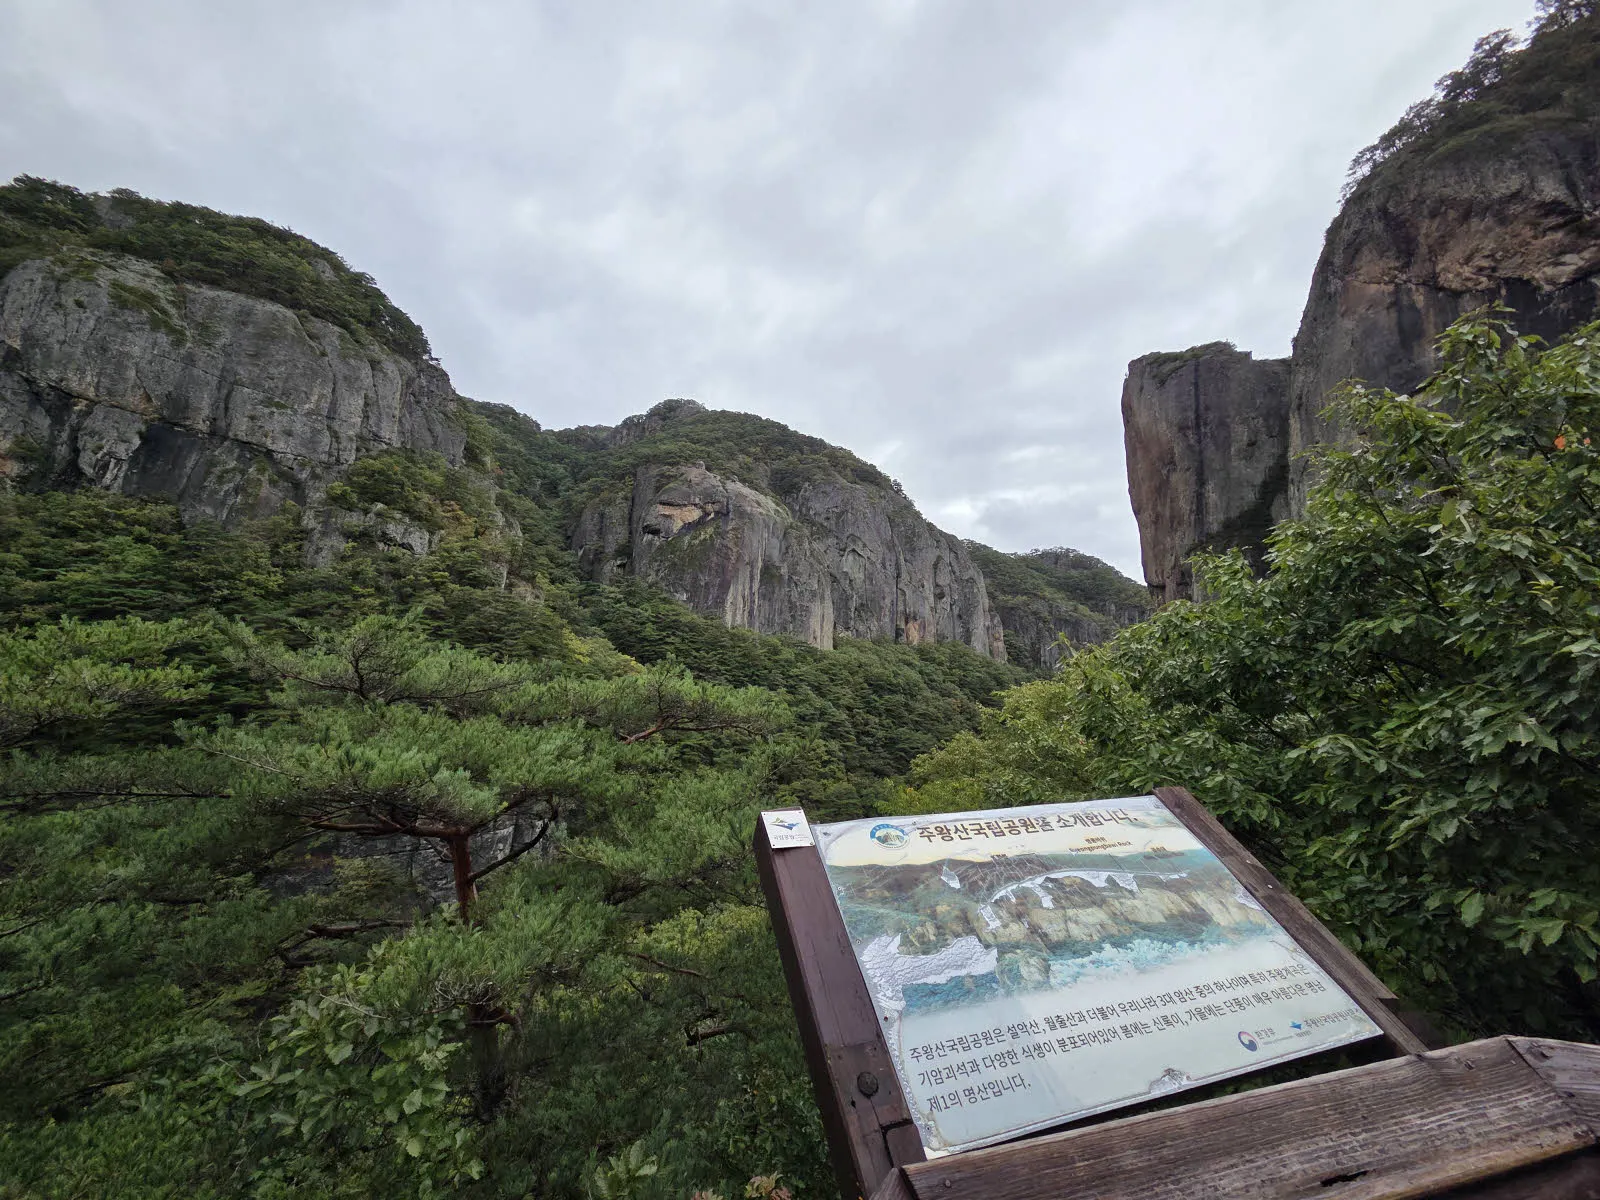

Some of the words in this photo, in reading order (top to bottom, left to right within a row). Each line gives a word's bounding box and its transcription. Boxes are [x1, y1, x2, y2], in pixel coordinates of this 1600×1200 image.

[1056, 808, 1138, 828] 소개합니다.
[909, 1028, 1005, 1063] 주왕산국립공원은
[1006, 1020, 1047, 1040] 설악산,
[1044, 1012, 1091, 1031] 월출산과
[1086, 1004, 1120, 1022] 더불어
[1118, 995, 1160, 1016] 우리나라
[1156, 991, 1176, 1008] 3대
[1175, 987, 1198, 1002] 암산
[1194, 983, 1216, 999] 중의
[1213, 975, 1251, 994] 하나이며
[1248, 970, 1270, 985] 특히
[1266, 964, 1310, 981] 주왕계곡은
[918, 1059, 981, 1087] 기암괴석과
[981, 1049, 1020, 1068] 다양한
[1021, 1040, 1057, 1059] 식생이
[1056, 1026, 1122, 1052] 분포되어있어
[1119, 1020, 1153, 1039] 봄에는
[1152, 1012, 1189, 1032] 신록이,
[1185, 1003, 1229, 1022] 가을에는
[1224, 996, 1256, 1013] 단풍이
[1252, 991, 1273, 1005] 매우
[1271, 983, 1308, 1000] 아름다운
[1304, 980, 1327, 994] 영남
[1254, 1027, 1276, 1040] 환경부
[926, 1091, 962, 1113] 제1의
[962, 1073, 1032, 1104] 명산입니다.
